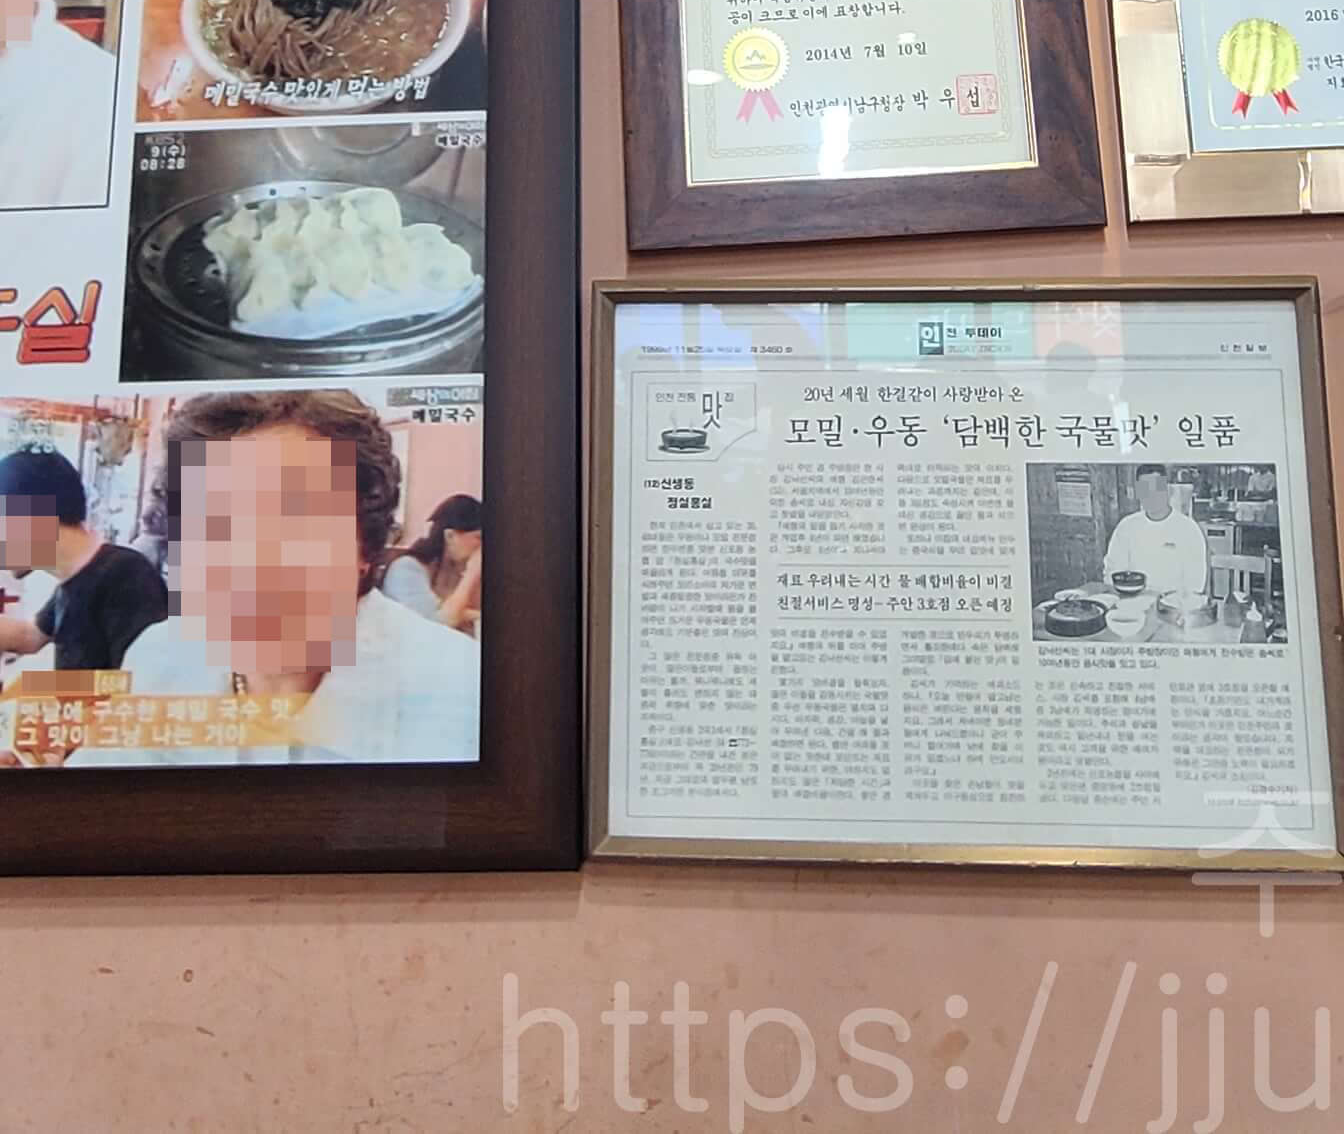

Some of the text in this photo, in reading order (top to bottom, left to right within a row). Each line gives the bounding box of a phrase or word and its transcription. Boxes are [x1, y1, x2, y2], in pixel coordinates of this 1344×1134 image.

[805, 41, 927, 61] 2014년 7월 10일
[391, 74, 431, 102] 방법
[965, 327, 1001, 338] 투데이
[803, 385, 1025, 403] 20년 세월 한결같이 사랑받아 온
[412, 406, 476, 423] 메밀국수
[1178, 414, 1241, 448] 일품
[777, 572, 1012, 590] 재료 우려내는 시간 물 배합비율이 비결
[777, 595, 1012, 613] 친절서비스 3호점 오픈 예정
